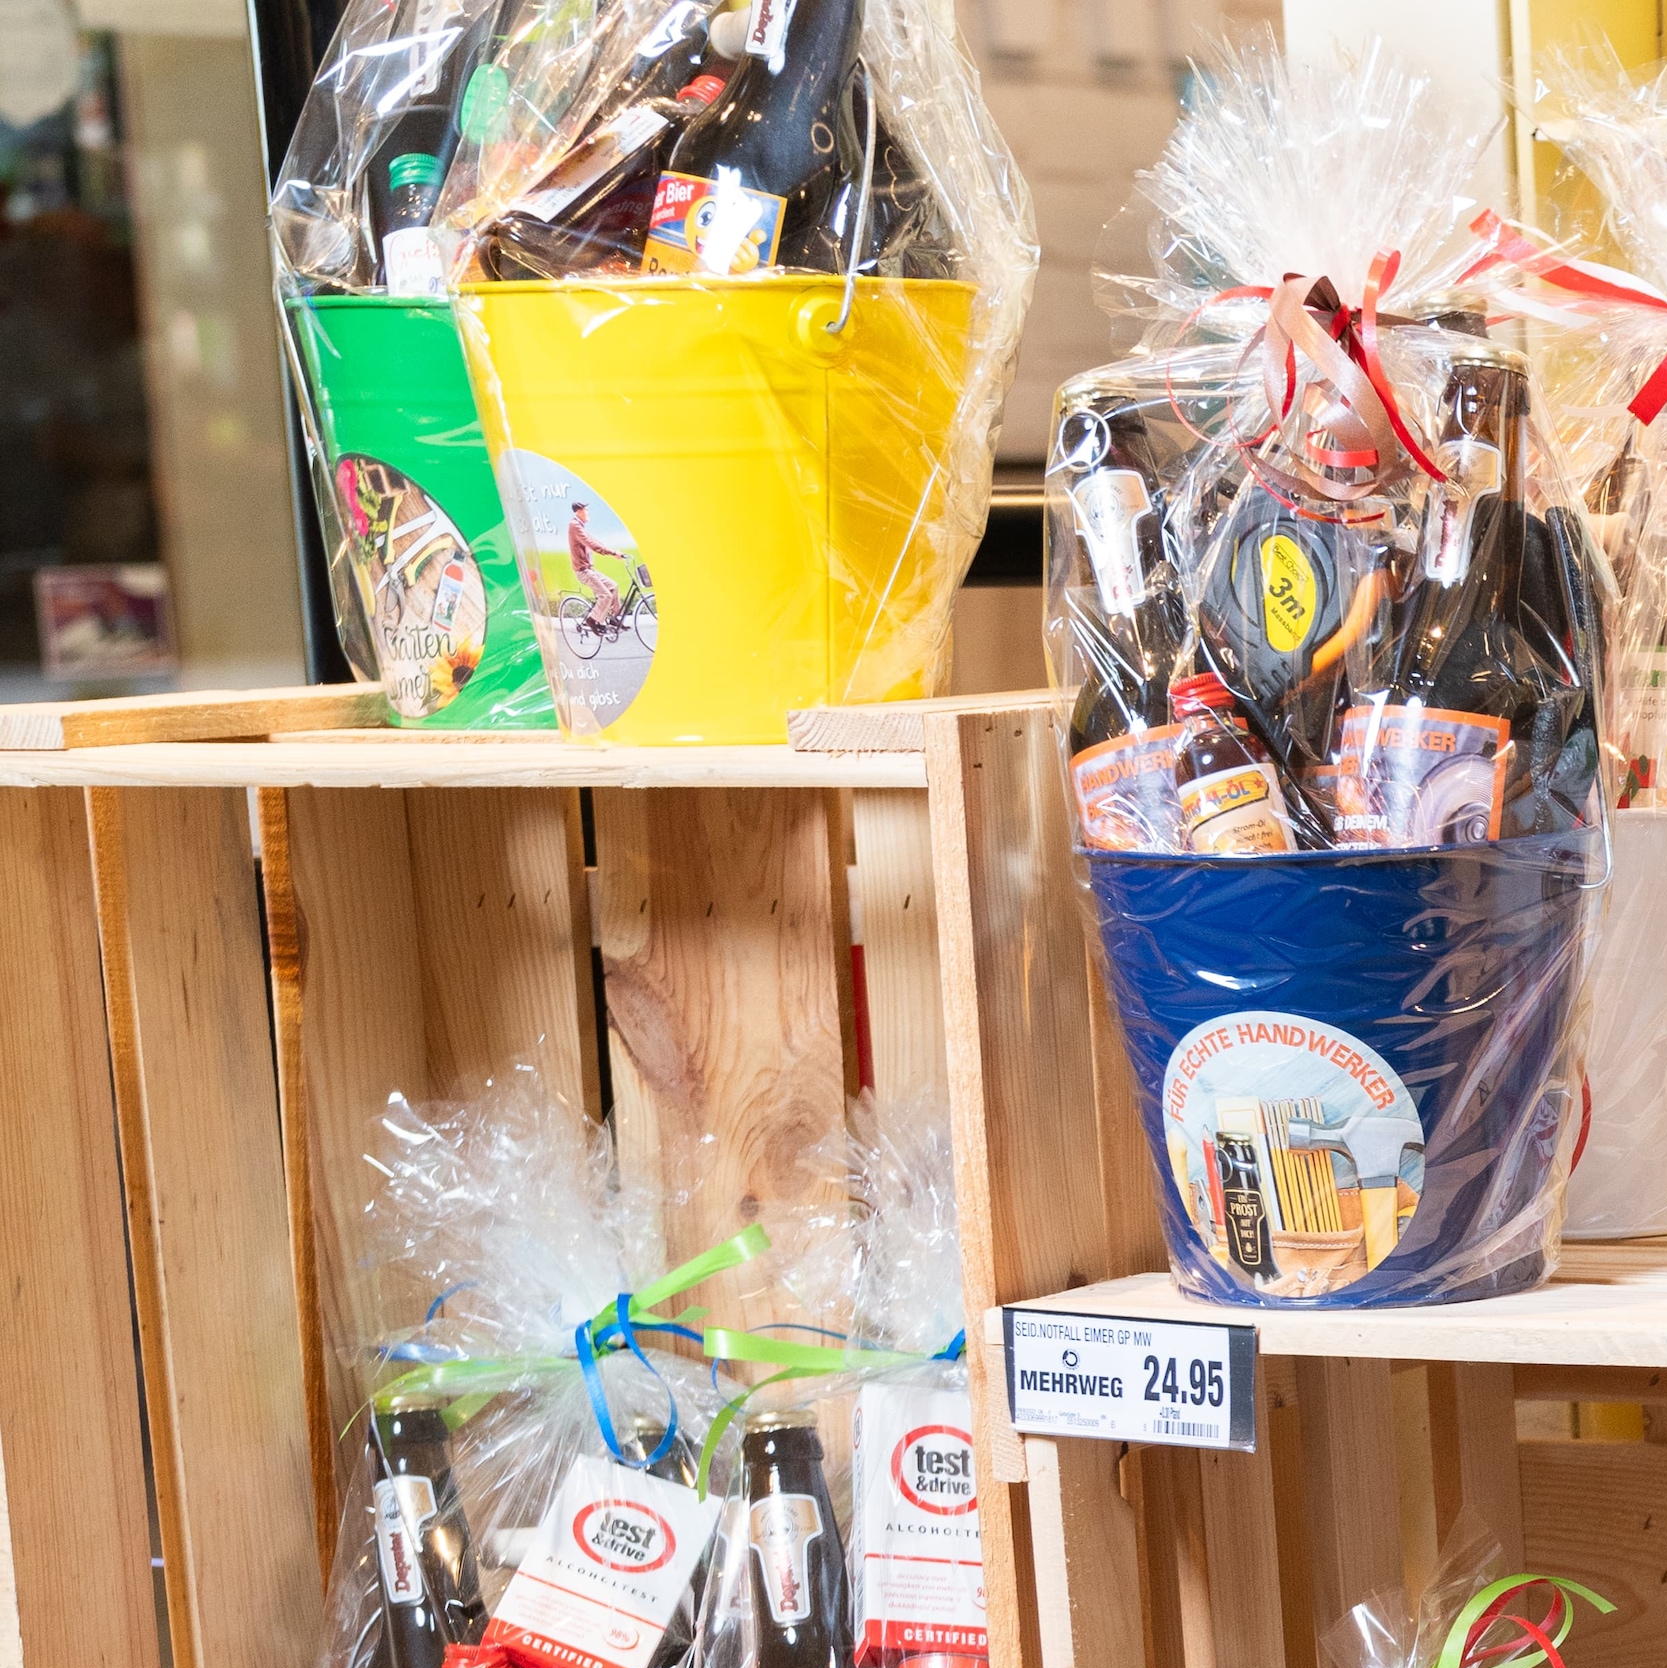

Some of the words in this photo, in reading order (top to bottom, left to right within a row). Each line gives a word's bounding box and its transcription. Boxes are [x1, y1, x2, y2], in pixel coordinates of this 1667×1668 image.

[666, 182, 694, 203] Bier
[1269, 577, 1305, 620] 3m
[383, 623, 458, 659] Garten
[577, 662, 599, 680] dich
[589, 691, 620, 711] gibst
[1179, 1027, 1234, 1078] ECHTE
[1237, 1022, 1396, 1111] HANDWERKER
[1169, 1079, 1190, 1124] FÜR
[1230, 1203, 1257, 1216] PROST
[1015, 1321, 1081, 1342] SEID.NOTFALL
[1084, 1327, 1114, 1344] EIMER
[1118, 1331, 1130, 1345] GP
[1134, 1333, 1152, 1347] MW
[1020, 1369, 1123, 1398] MEHRWEG
[1144, 1355, 1224, 1407] 24.95
[915, 1445, 970, 1477] test
[916, 1476, 971, 1495] &drive
[592, 1534, 646, 1561] &drive
[904, 1628, 987, 1646] CERTIFIED
